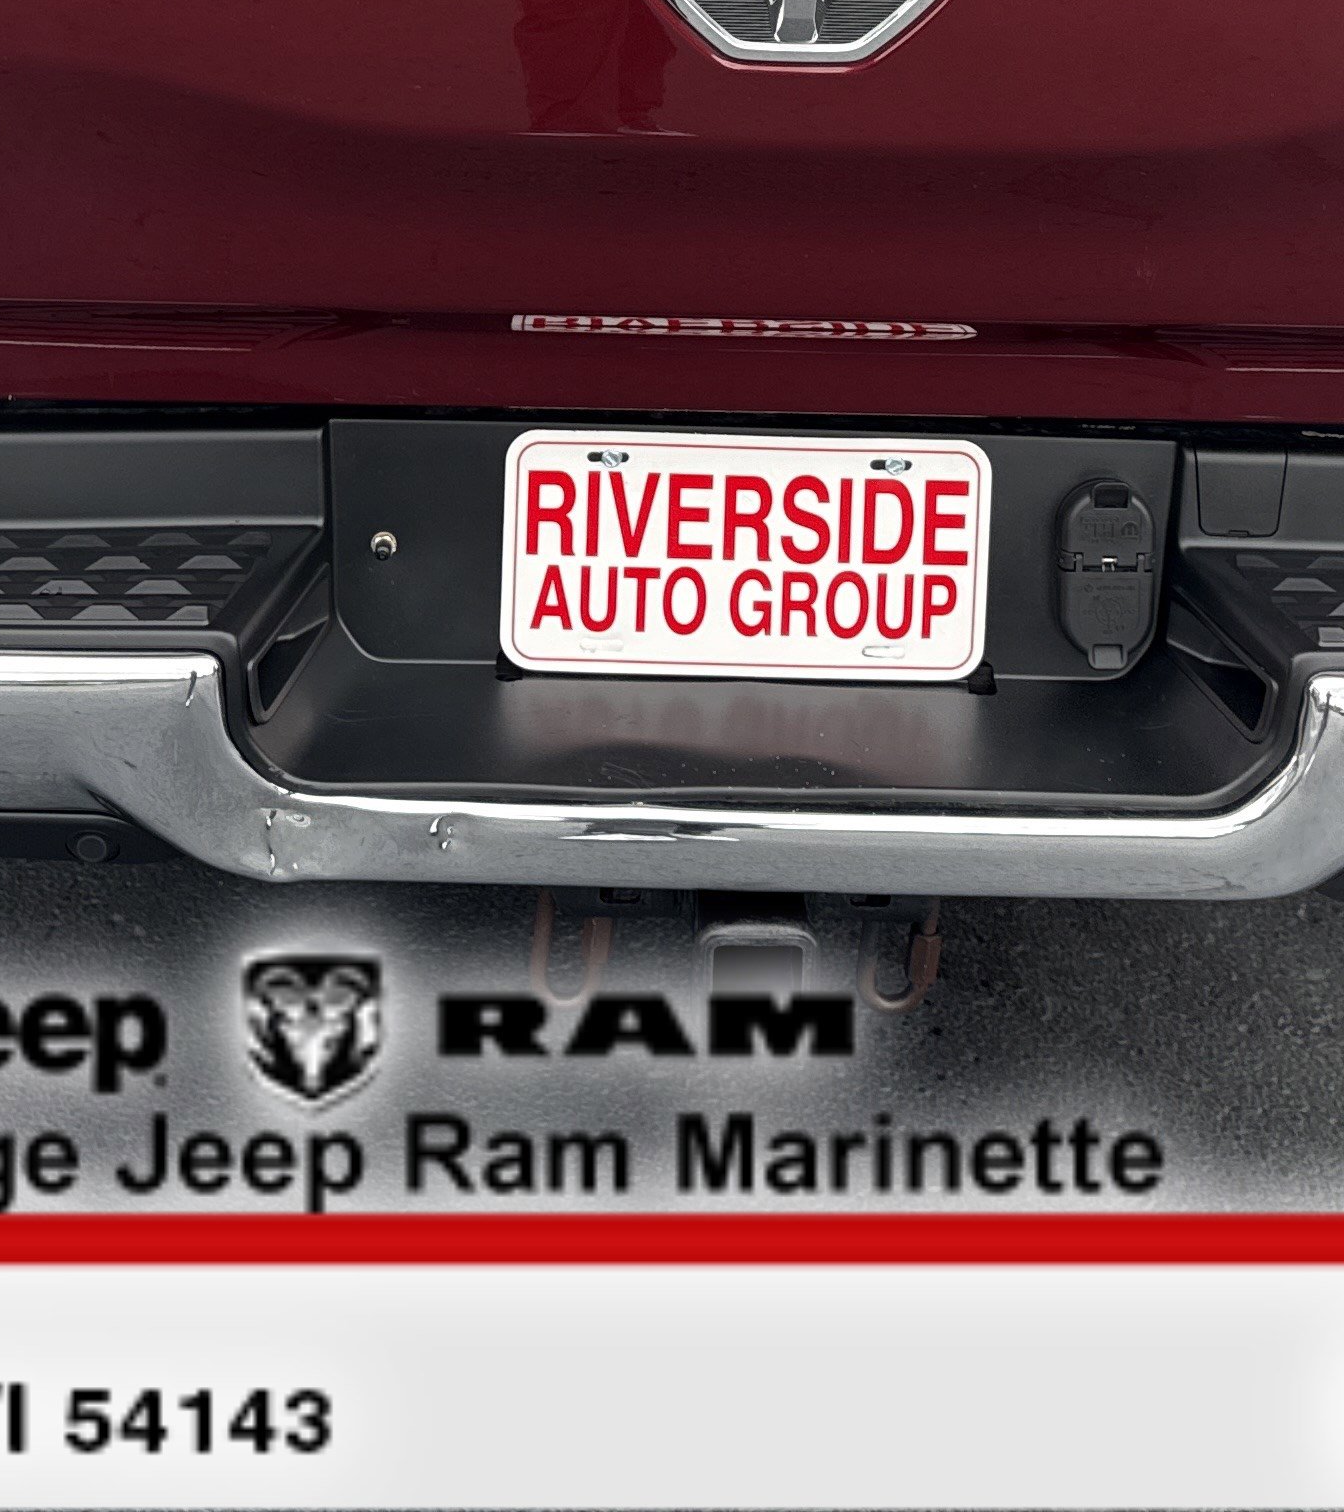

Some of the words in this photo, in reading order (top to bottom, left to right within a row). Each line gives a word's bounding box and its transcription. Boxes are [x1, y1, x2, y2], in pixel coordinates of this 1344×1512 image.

[525, 470, 970, 566] RIVERSIDE
[530, 564, 707, 635] AUTO
[729, 568, 957, 640] GROUP
